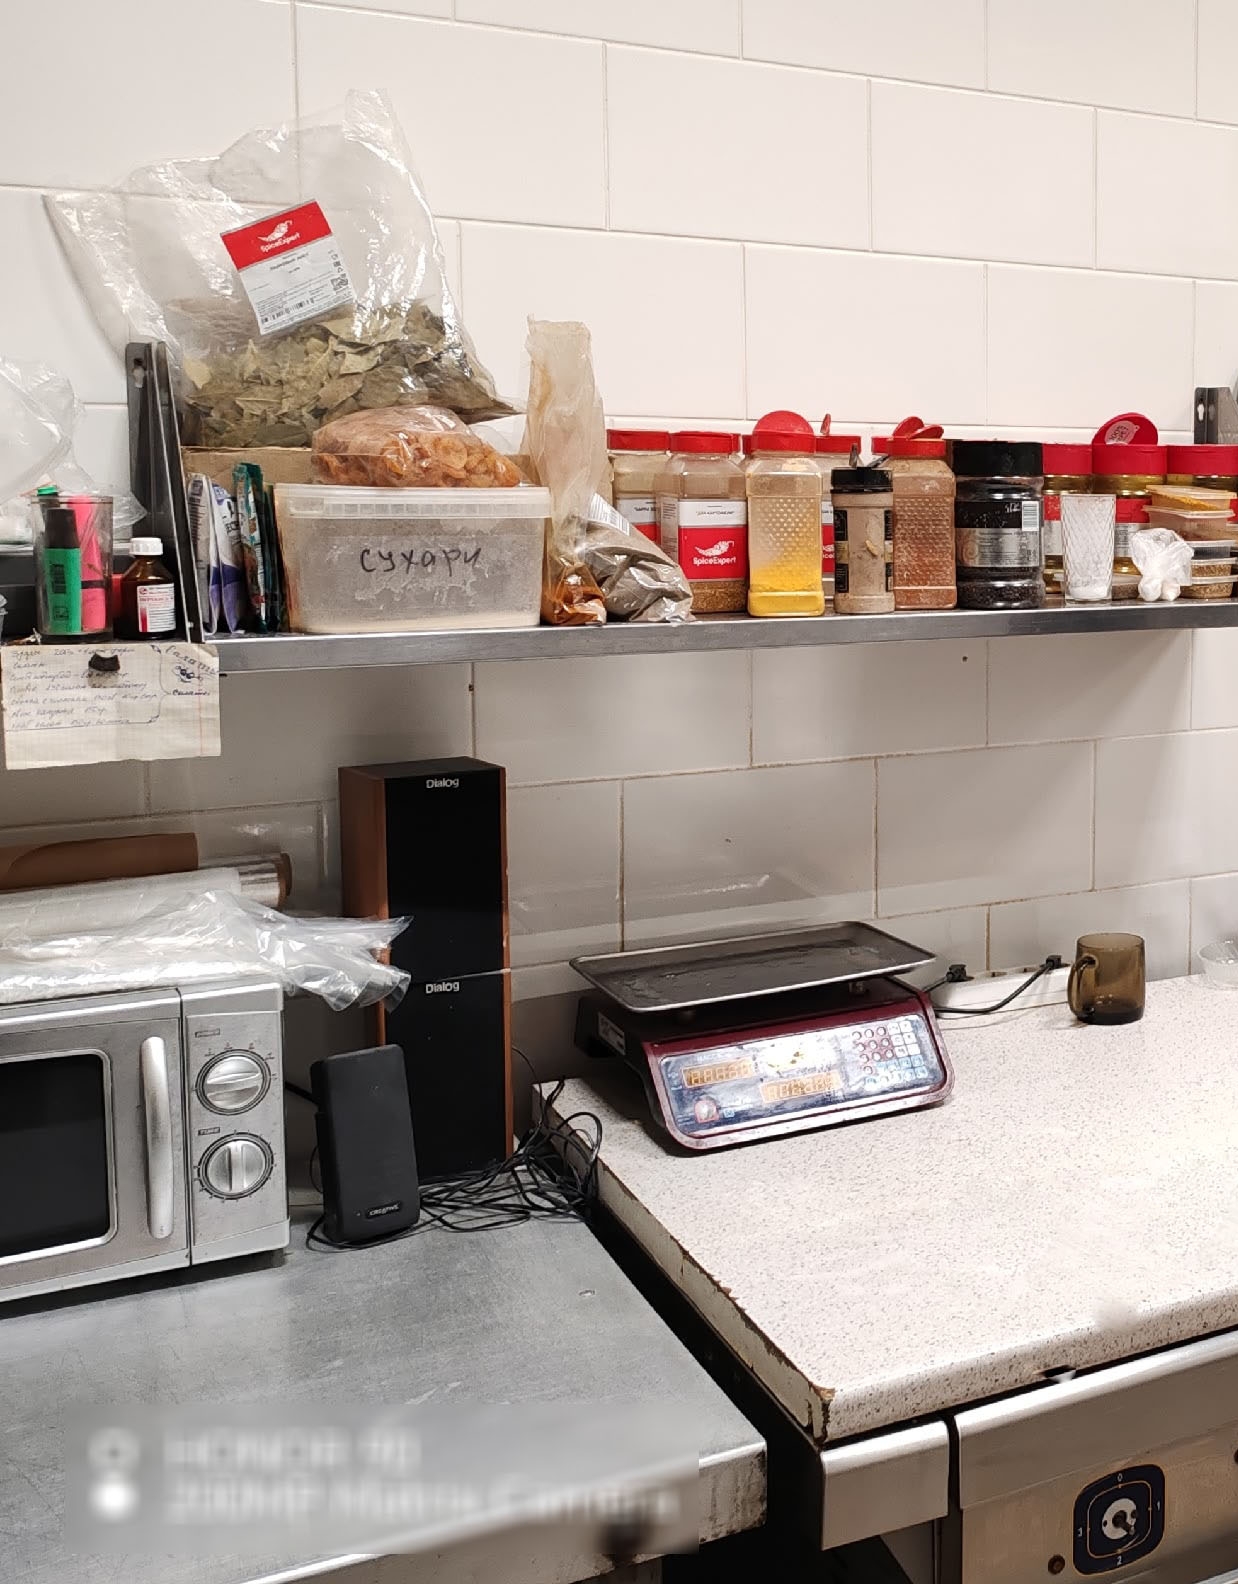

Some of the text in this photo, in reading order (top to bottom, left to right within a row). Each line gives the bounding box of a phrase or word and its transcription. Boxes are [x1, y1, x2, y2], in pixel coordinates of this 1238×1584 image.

[692, 556, 737, 567] SpiceExpert
[425, 778, 460, 789] Dialog
[425, 981, 460, 994] Dialog
